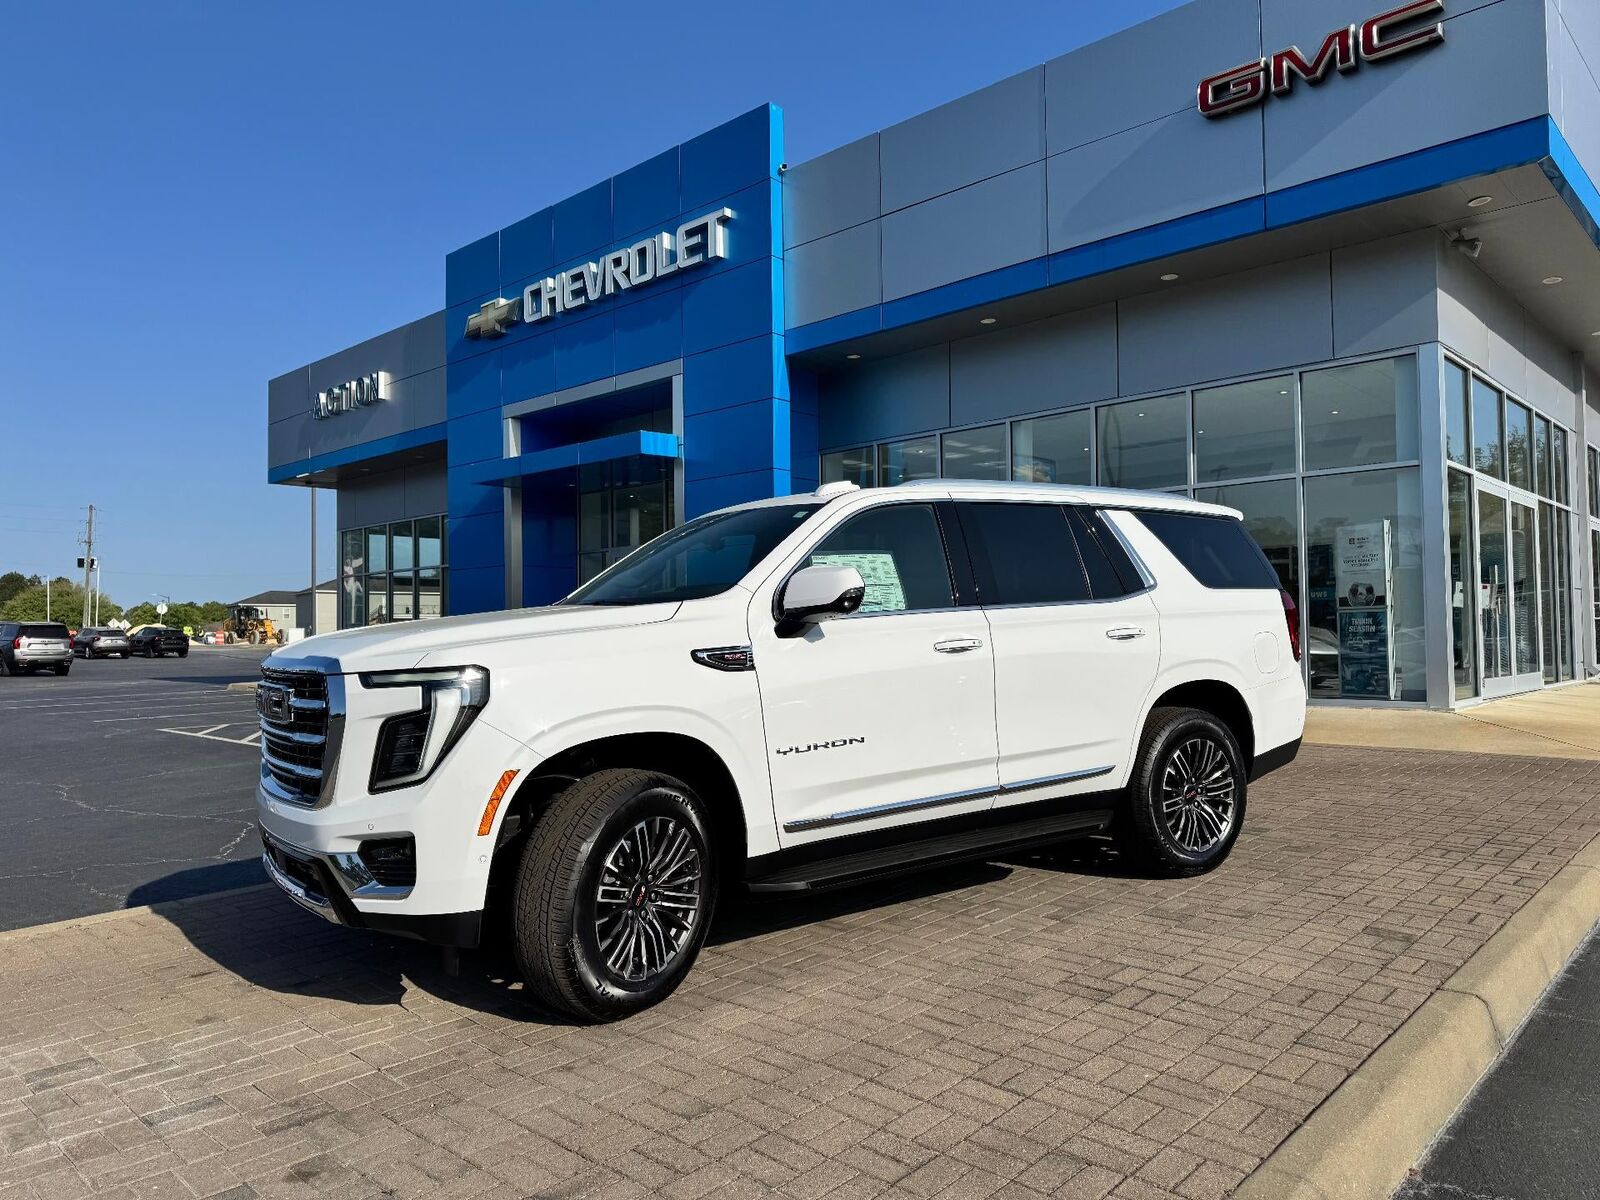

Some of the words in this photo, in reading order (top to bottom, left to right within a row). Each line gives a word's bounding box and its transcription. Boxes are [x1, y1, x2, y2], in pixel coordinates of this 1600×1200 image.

[1197, 0, 1444, 117] GMC
[523, 206, 732, 323] CHEVROLET
[312, 371, 386, 420] ACTION
[776, 737, 864, 755] YUKON
